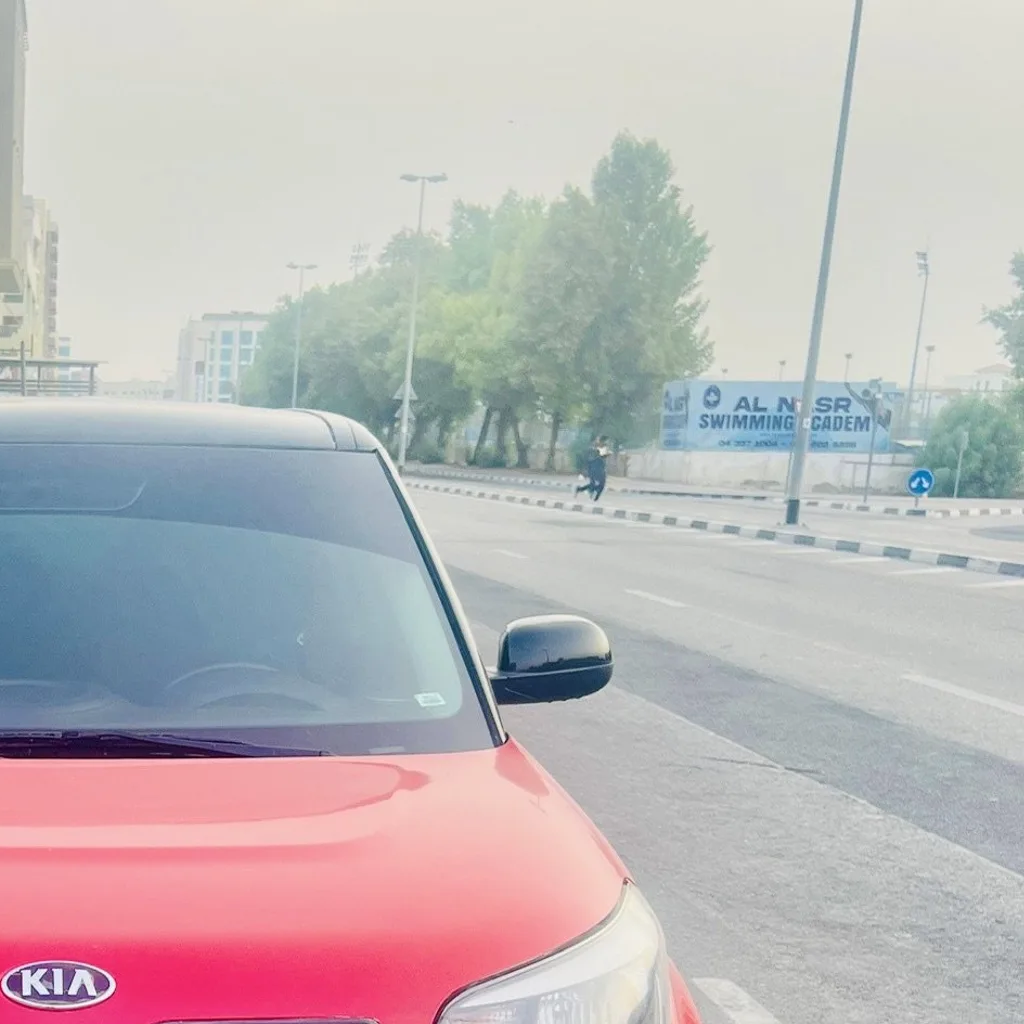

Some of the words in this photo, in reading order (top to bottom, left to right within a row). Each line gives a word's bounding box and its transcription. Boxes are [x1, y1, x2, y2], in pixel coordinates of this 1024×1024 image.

[733, 396, 767, 413] AL
[777, 396, 851, 413] NSR
[699, 413, 794, 430] SWIMMING
[809, 415, 870, 432] CADEM
[20, 968, 97, 996] KIA
